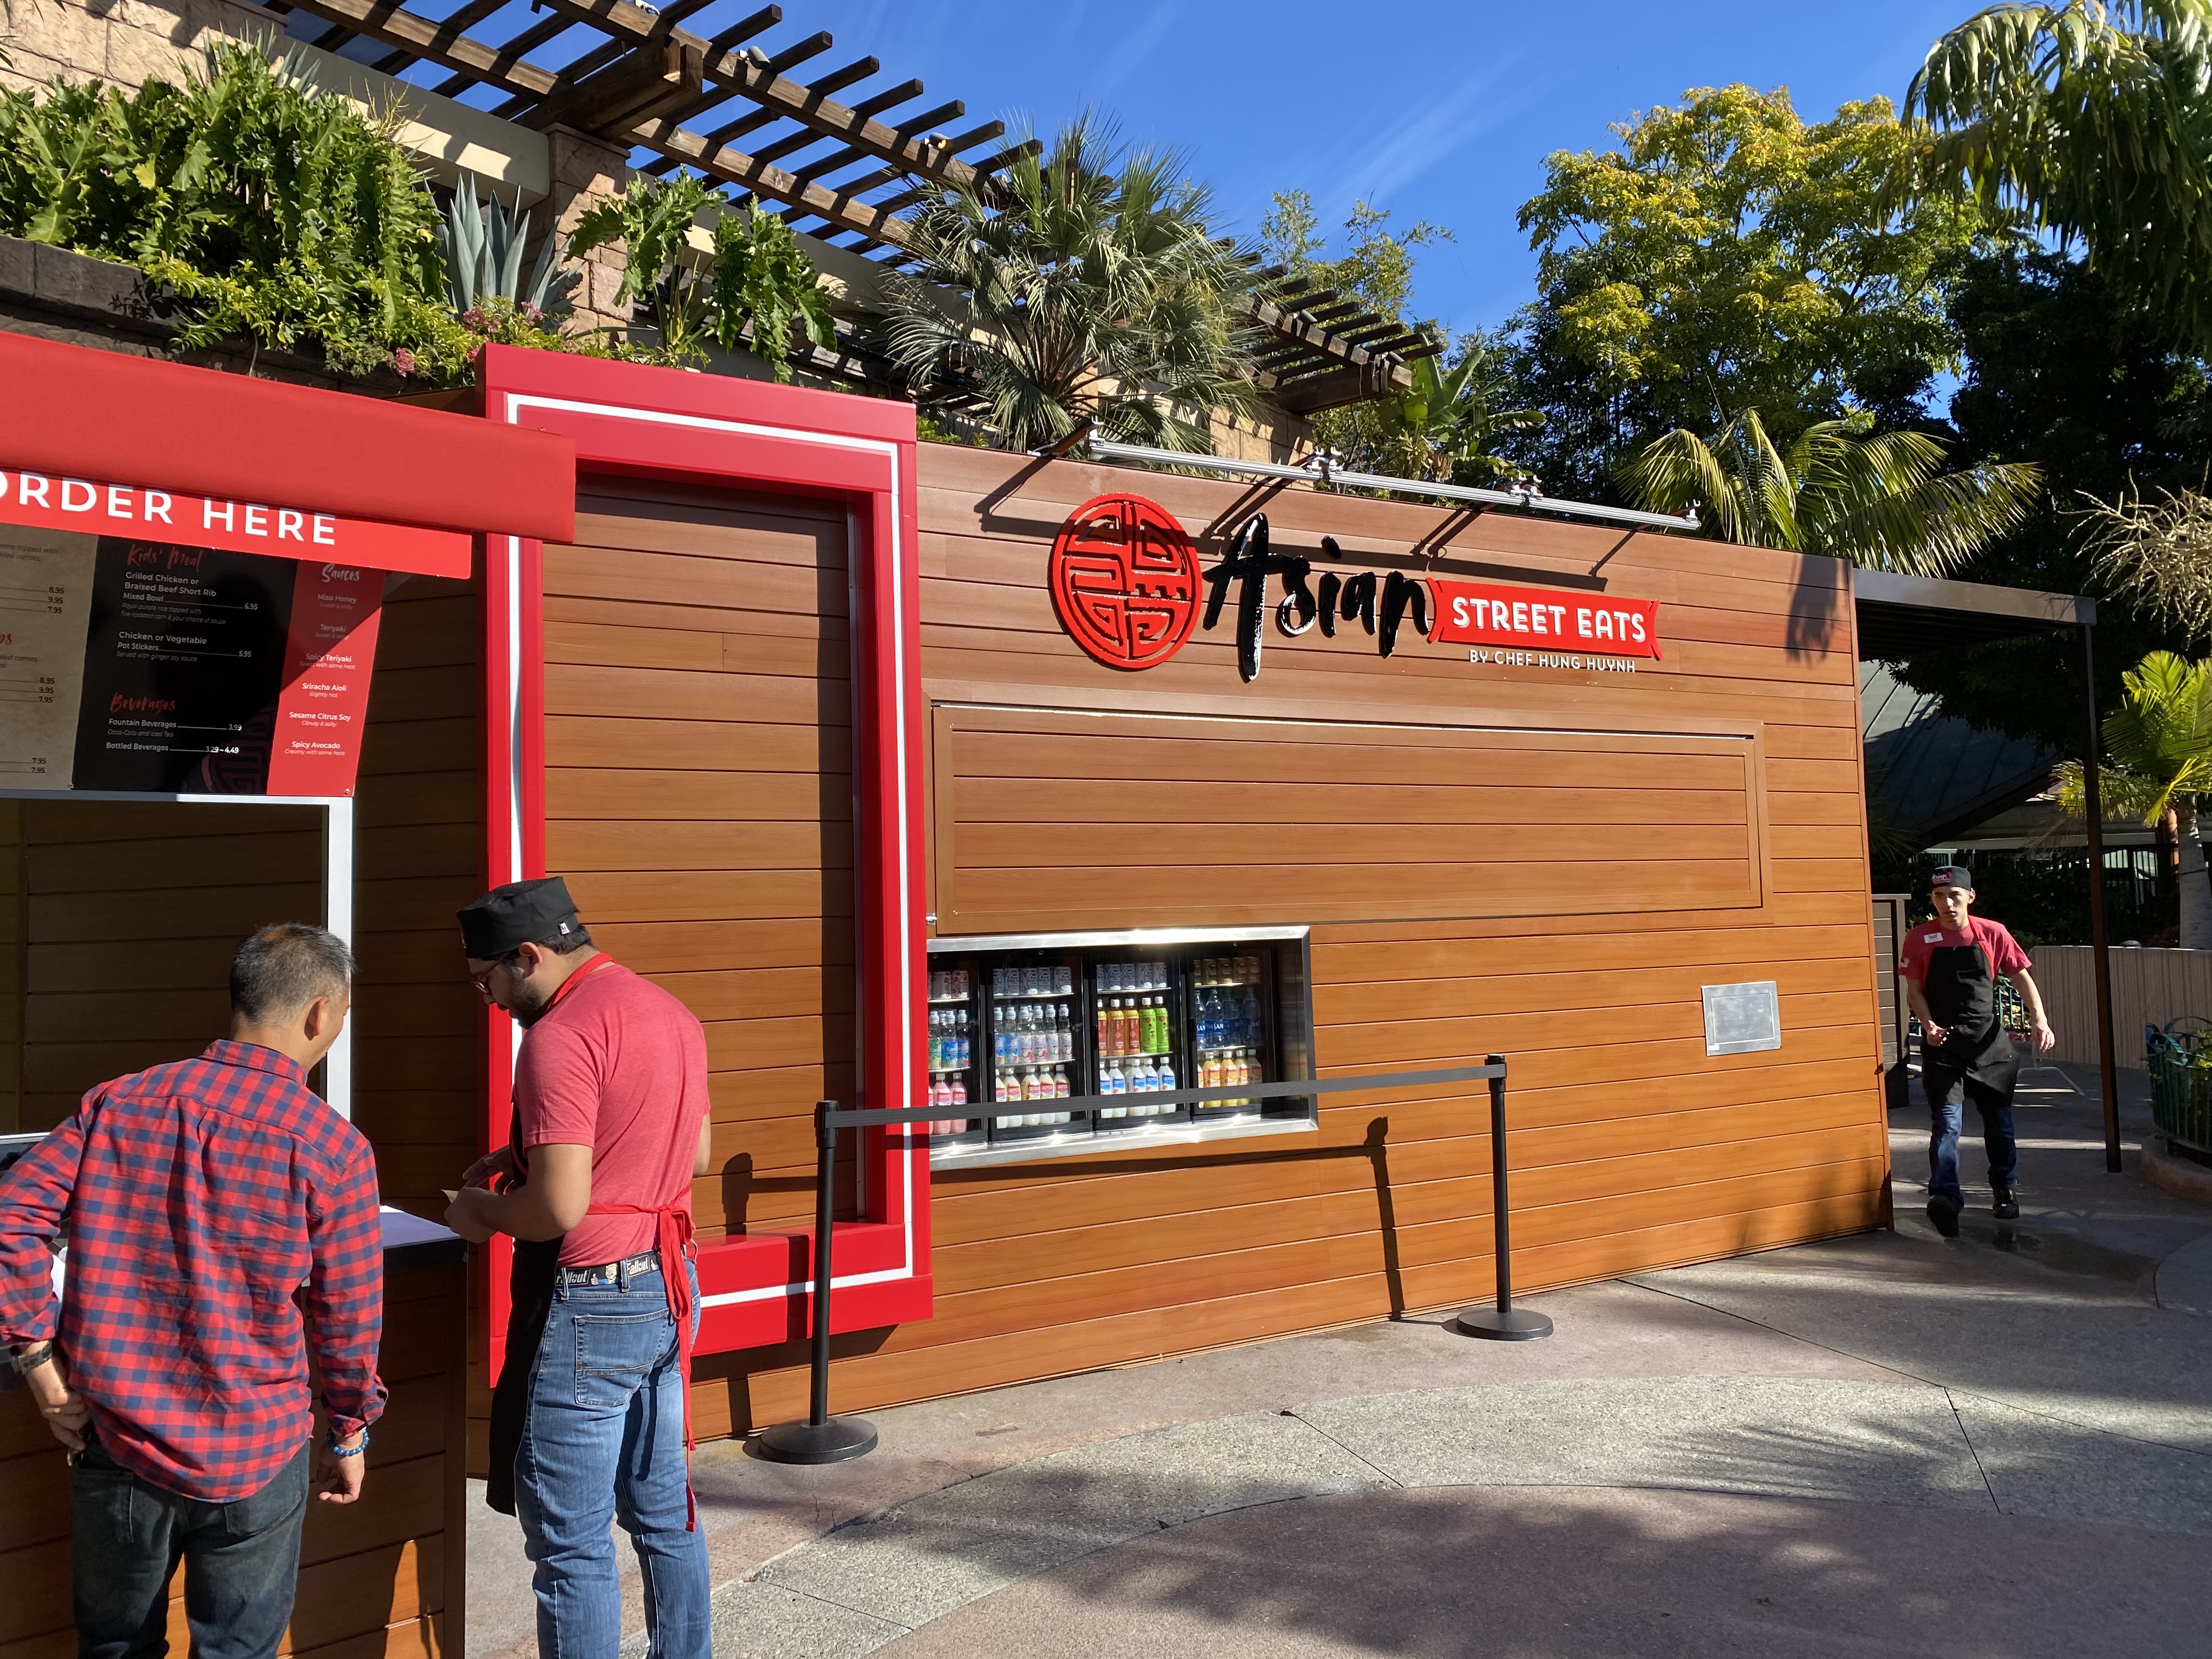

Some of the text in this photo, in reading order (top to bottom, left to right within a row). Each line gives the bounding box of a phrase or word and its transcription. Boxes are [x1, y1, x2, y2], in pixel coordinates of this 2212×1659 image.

[0, 471, 336, 545] RDER HERE
[167, 546, 204, 572] Meal
[126, 572, 153, 580] Grilled
[155, 574, 188, 584] Chicken
[321, 563, 360, 583] Sauces
[125, 582, 156, 591] Braised
[158, 585, 178, 593] Beef
[179, 587, 201, 595] Short
[335, 595, 357, 604] Honey
[1203, 512, 1430, 683] Asian
[1452, 596, 1646, 642] STREET EATS
[320, 624, 346, 633] Teriyaki
[119, 631, 153, 641] Chicken
[166, 635, 207, 645] Vegetable
[306, 653, 352, 663] Spicy Teriyaki
[1469, 649, 1636, 673] BY CHEF HUNG HUYNH
[302, 682, 330, 691] Sriracha
[110, 691, 176, 714] Beverages
[141, 720, 177, 729] Beverages
[133, 743, 169, 752] Beverages
[291, 741, 310, 749] Spicy
